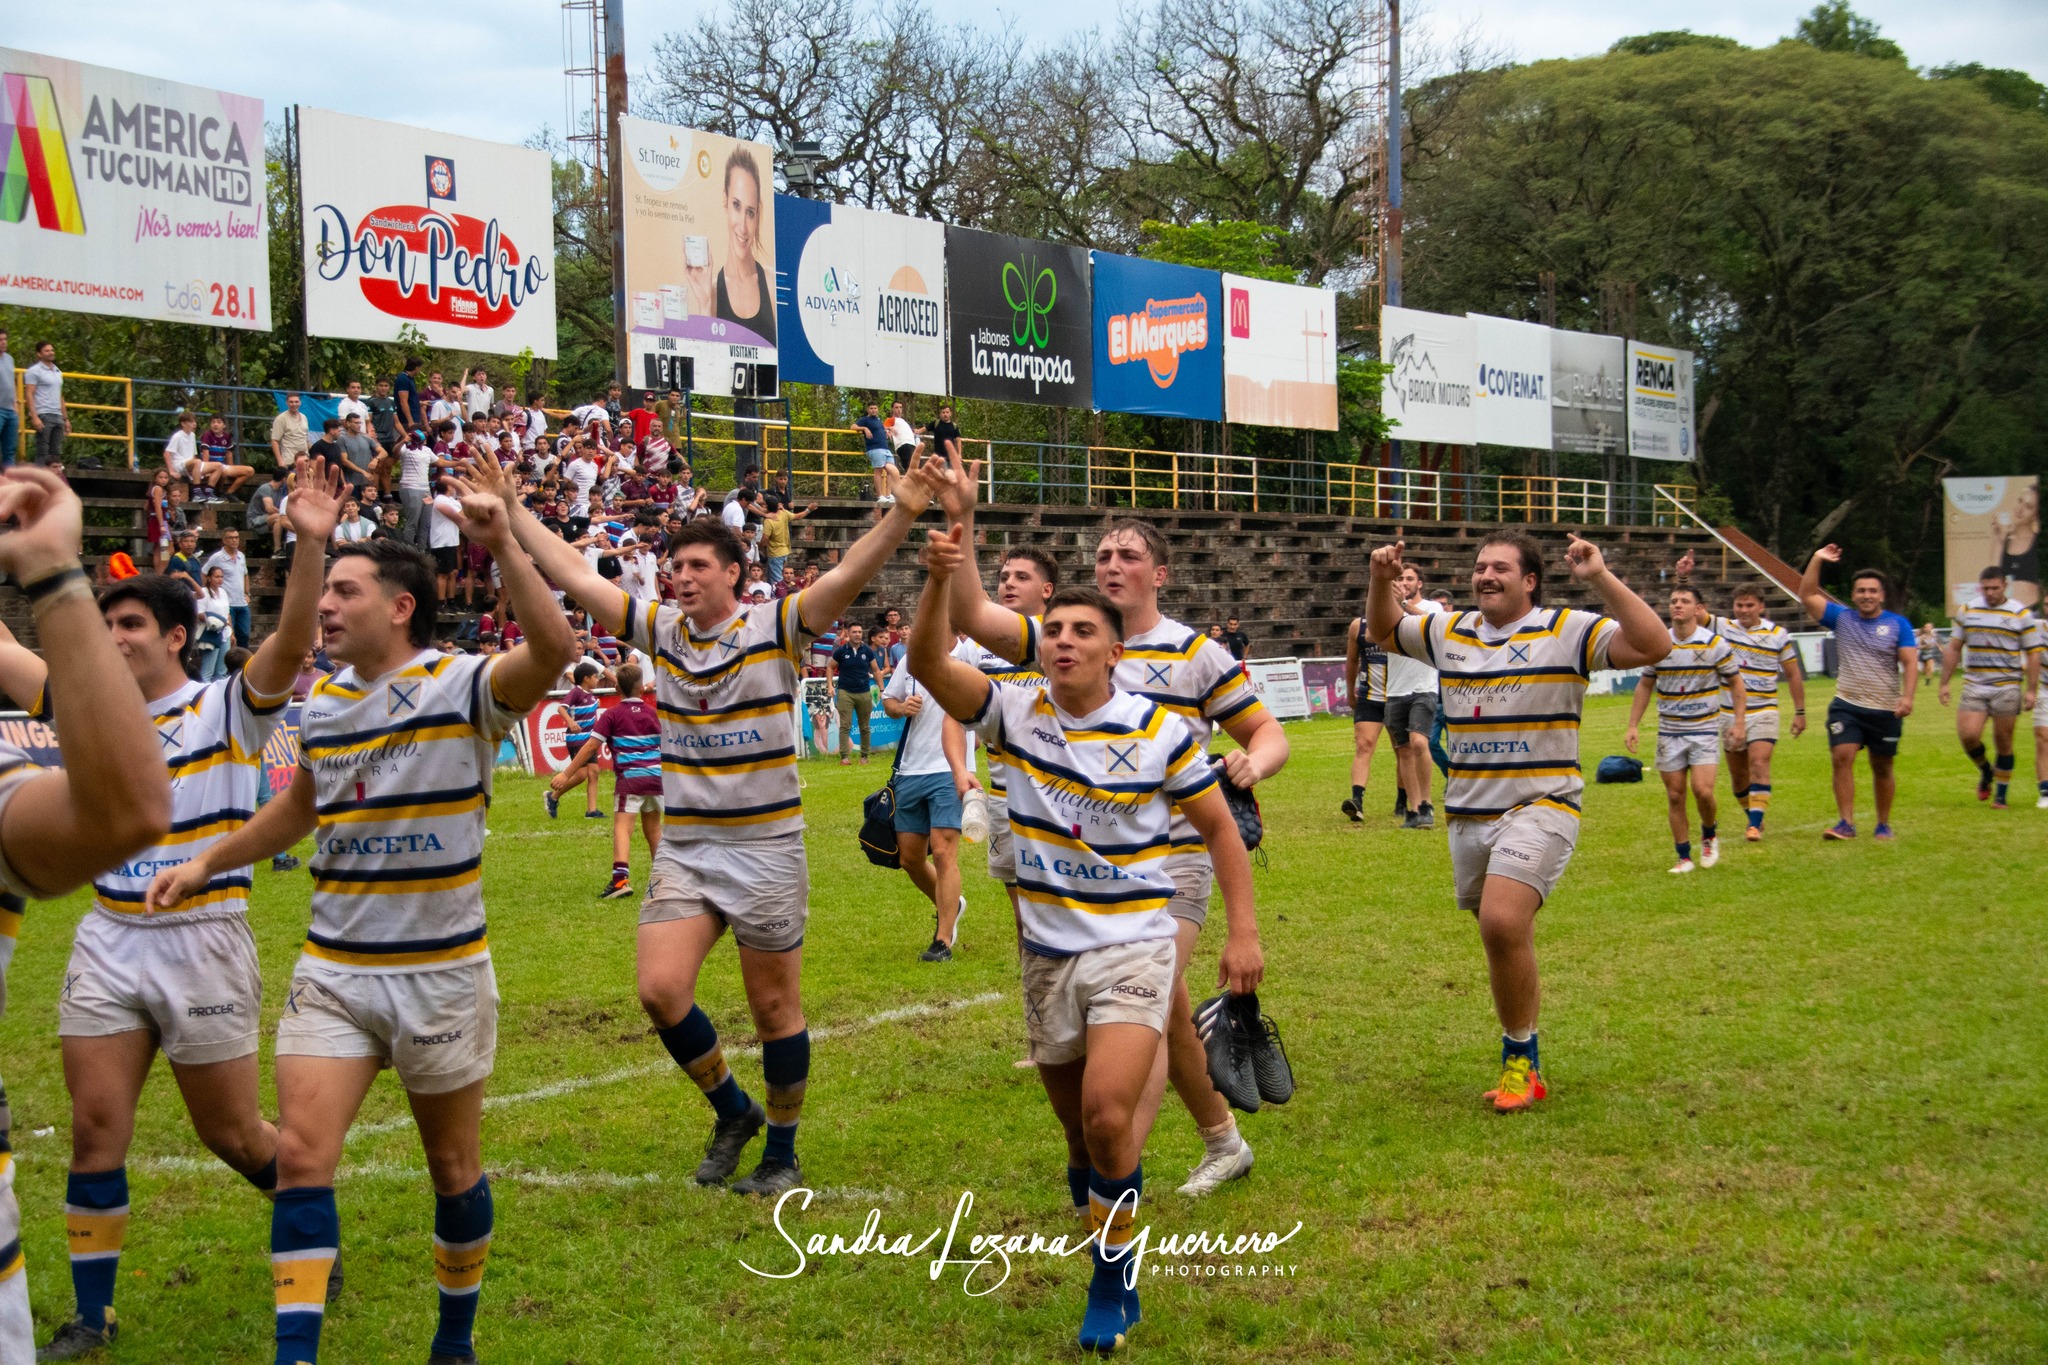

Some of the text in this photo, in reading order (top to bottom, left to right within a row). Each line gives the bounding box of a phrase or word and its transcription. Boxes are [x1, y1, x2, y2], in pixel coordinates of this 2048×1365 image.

[82, 94, 250, 167] AMERICA
[82, 146, 252, 207] TUCUMAN HD
[135, 203, 262, 243] ¡Nos vemos bien!
[654, 210, 670, 220] siento
[313, 204, 549, 307] Don Pedro
[164, 281, 256, 321] tda 28.1
[1149, 299, 1204, 320] Supermercado
[805, 294, 938, 338] ADVANTA AGROSEED
[658, 337, 677, 350] LOCAL
[978, 328, 1010, 347] Jabones
[1111, 317, 1206, 358] El Marques
[729, 345, 758, 359] VISITANTE
[970, 334, 1075, 395] la mariposa
[1636, 358, 1675, 391] RENOA
[1408, 379, 1470, 408] BROOK MOTORS
[1447, 675, 1522, 696] Michelob
[683, 729, 764, 748] GACETA
[1459, 741, 1530, 754] GACETA
[314, 730, 418, 775] Michelob
[329, 763, 400, 782] ULTRA
[1027, 771, 1140, 816] Michelob
[328, 833, 446, 855] GACETA
[1020, 849, 1047, 871] LA
[1111, 985, 1157, 1000] PROCER
[188, 1003, 234, 1017] PROCER
[413, 1029, 462, 1046] PROCER
